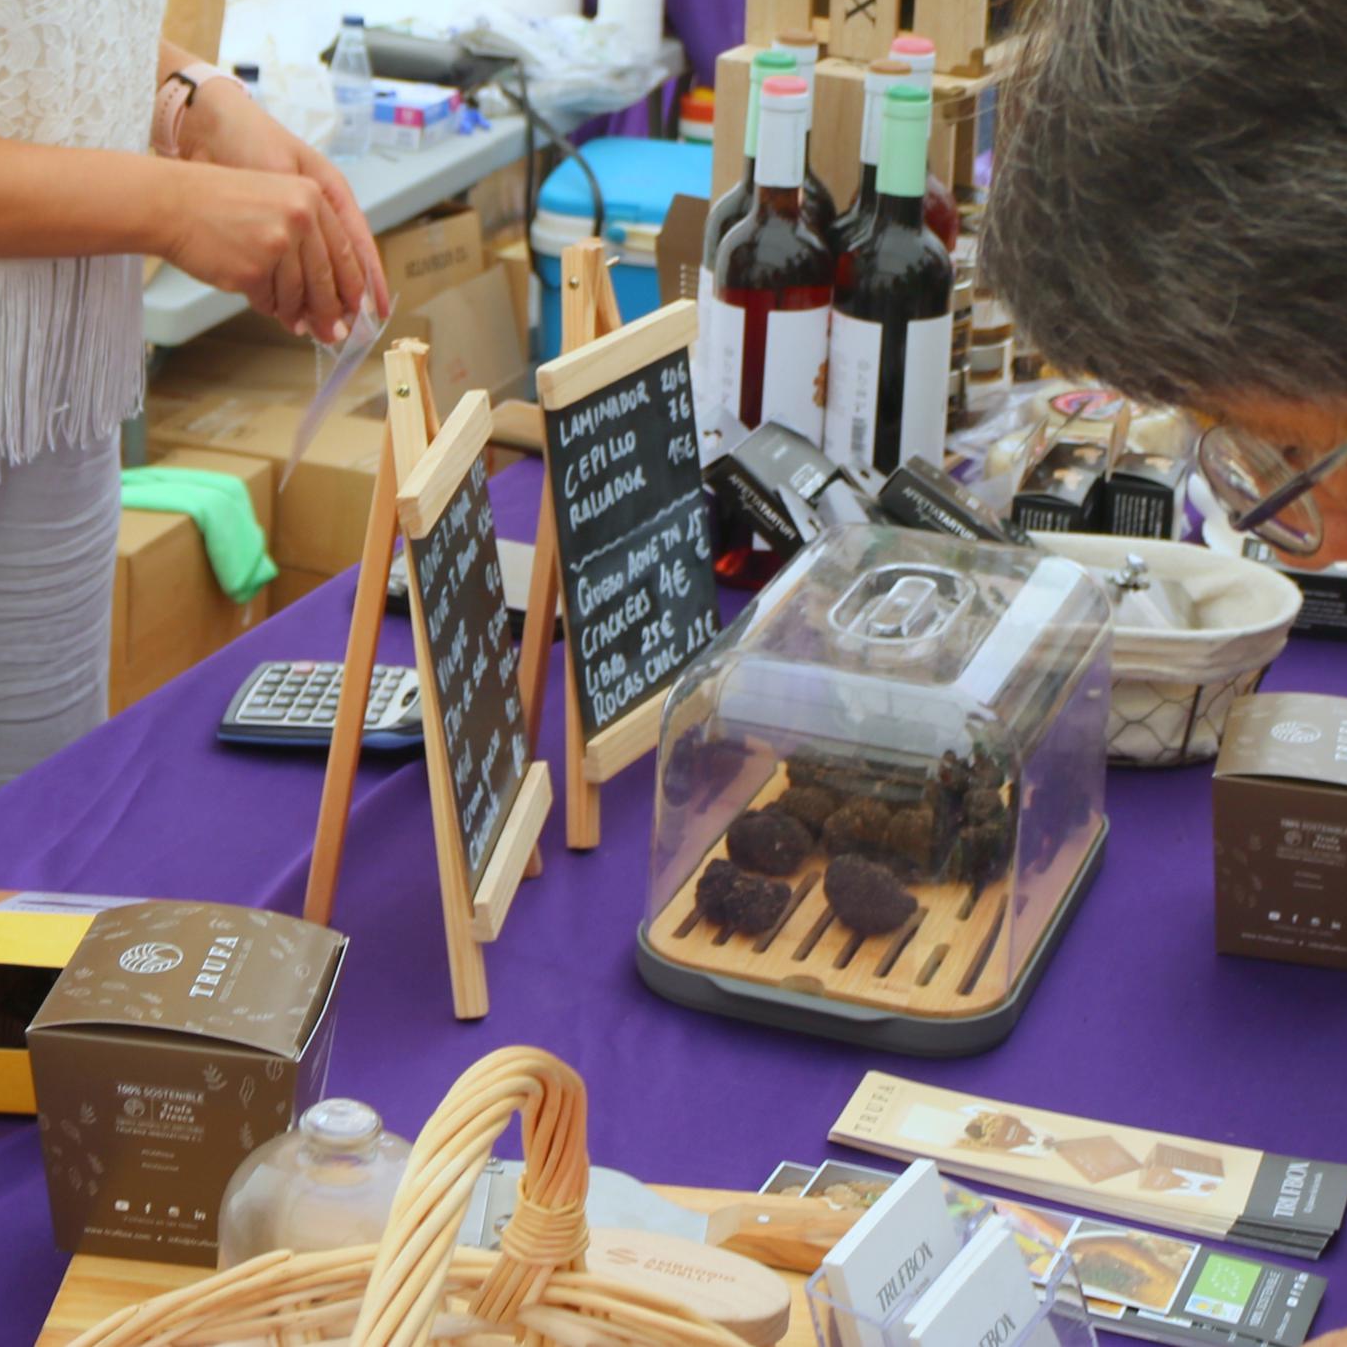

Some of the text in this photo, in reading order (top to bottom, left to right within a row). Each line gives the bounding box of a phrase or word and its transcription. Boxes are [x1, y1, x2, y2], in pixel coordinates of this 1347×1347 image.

[560, 381, 649, 445] LAMINADOR
[668, 392, 690, 421] 7€
[668, 433, 695, 463] 15€
[581, 559, 690, 658] CRACKERS 4€
[641, 610, 674, 654] 25€
[189, 935, 239, 998] TRUFA
[143, 1086, 205, 1104] SOSTENIBLE
[853, 1084, 897, 1133] TRUFA
[876, 1240, 934, 1313] TRUFBOX
